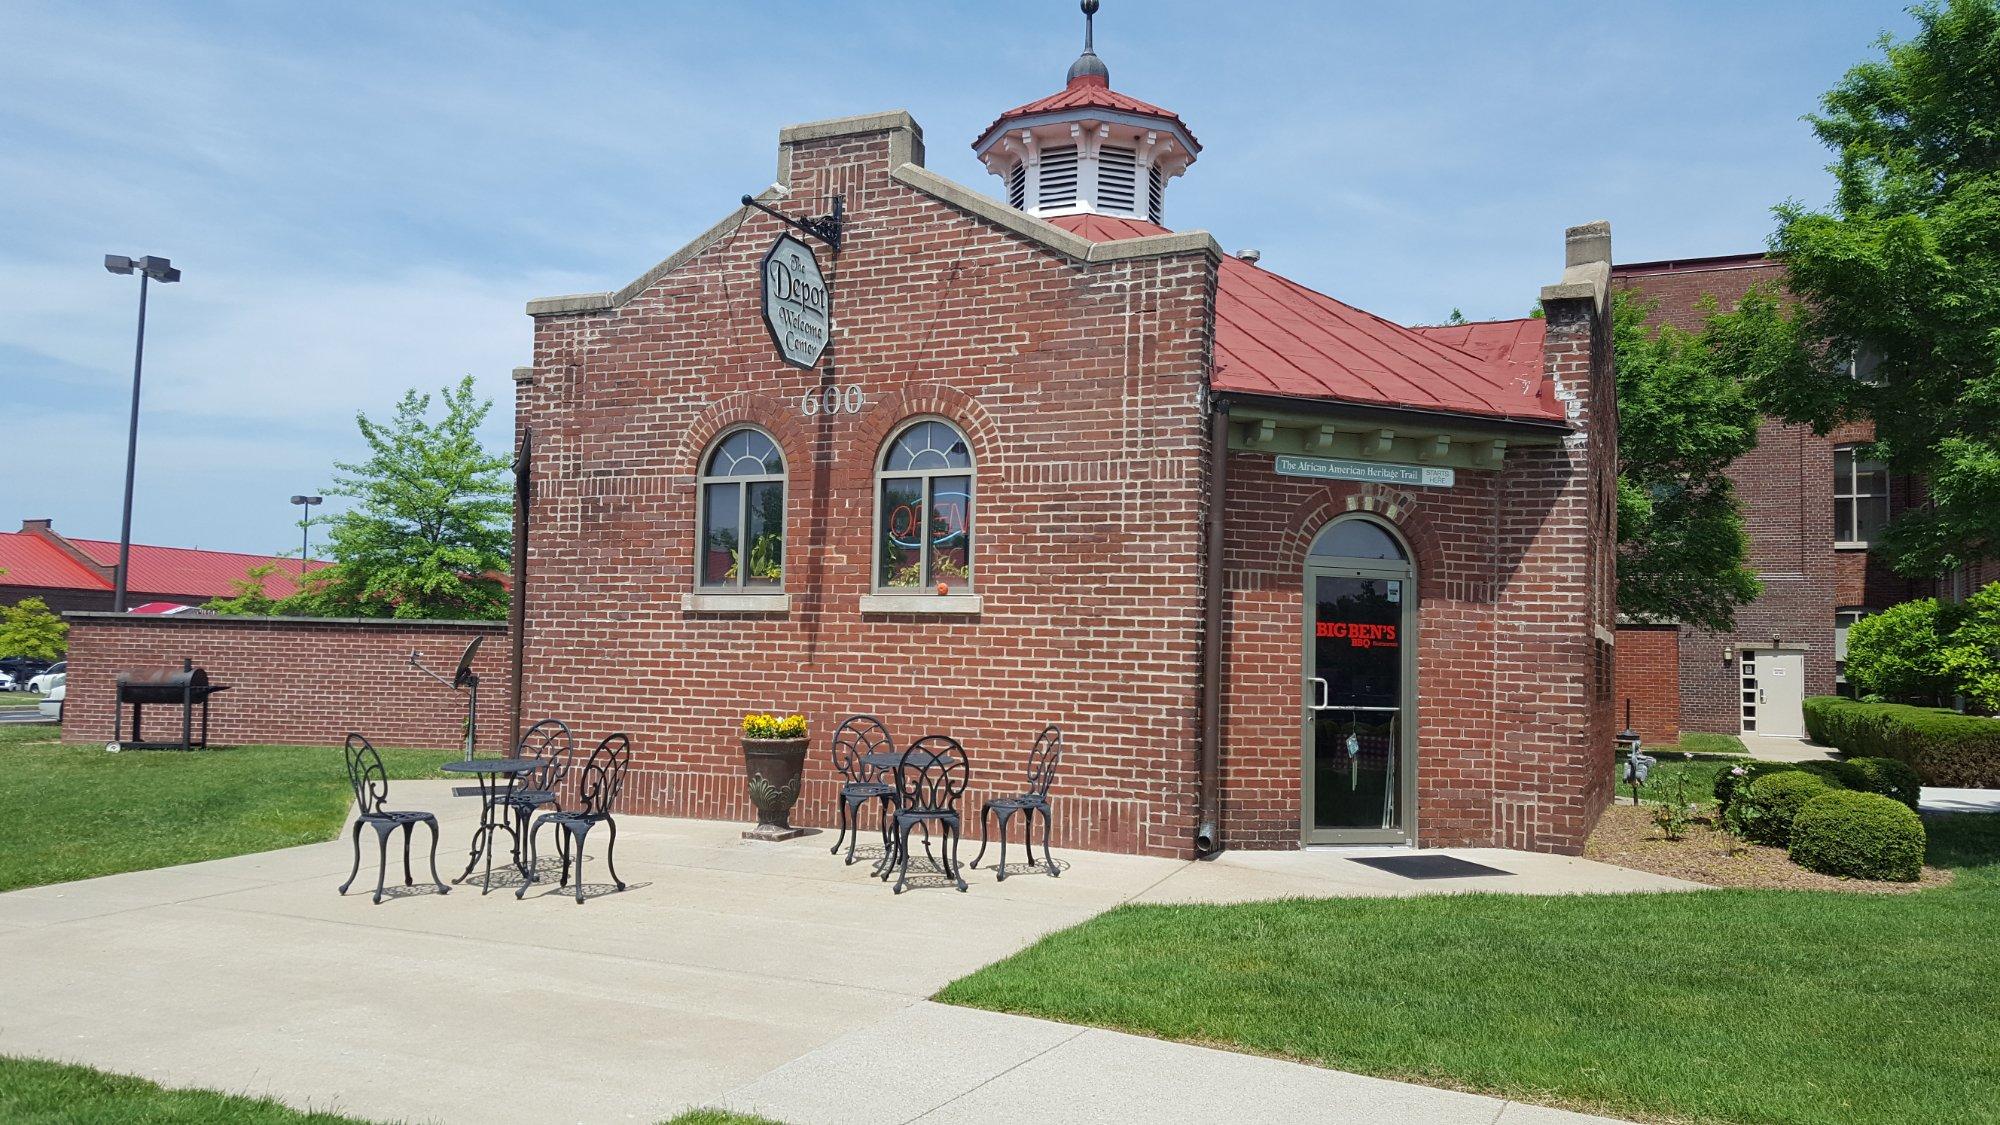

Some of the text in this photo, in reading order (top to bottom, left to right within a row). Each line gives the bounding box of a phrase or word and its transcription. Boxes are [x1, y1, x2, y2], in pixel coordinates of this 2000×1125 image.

[791, 254, 805, 274] The
[770, 259, 825, 312] Depot
[779, 306, 822, 339] Welcome
[786, 331, 816, 355] Center
[801, 384, 864, 416] 600
[1281, 459, 1418, 480] The African American Heritage Trail
[1316, 622, 1396, 640] BIG BEN'S
[1351, 639, 1371, 649] BBQ
